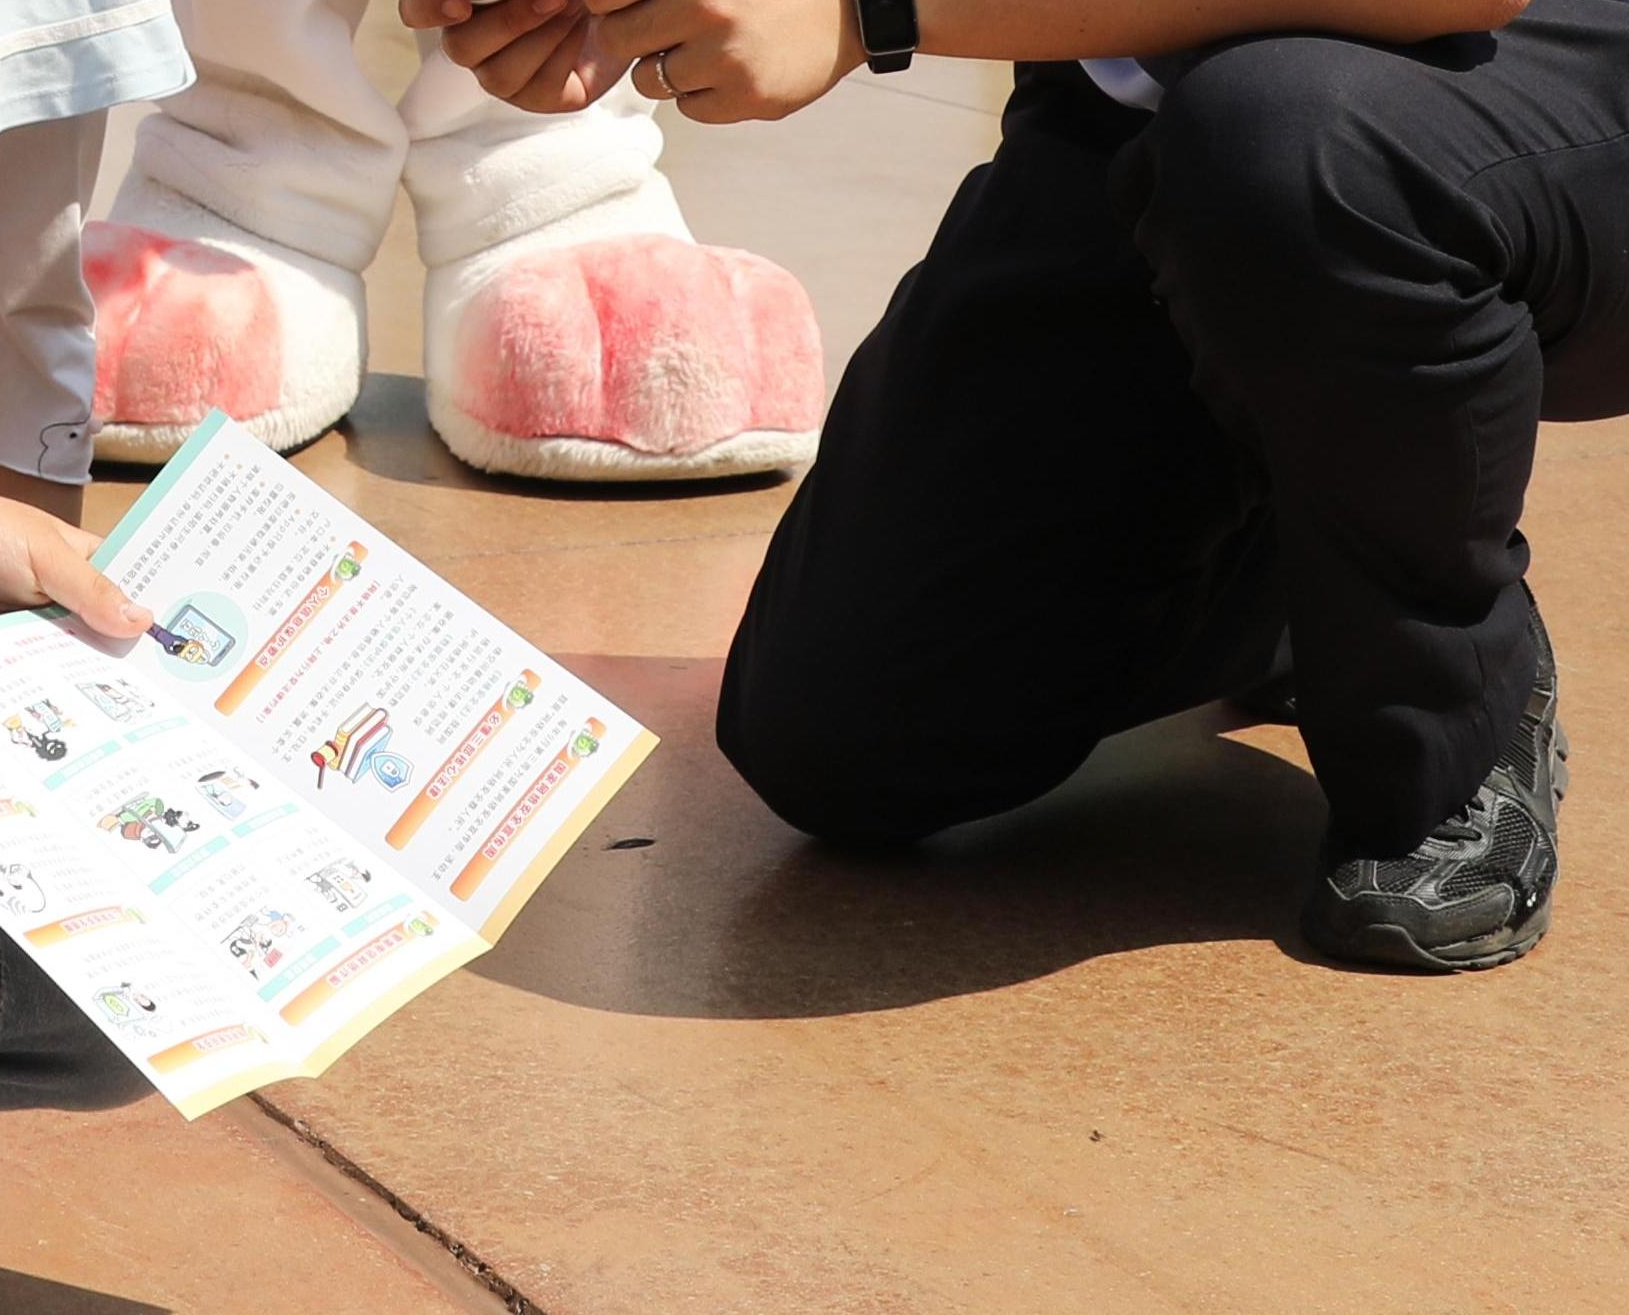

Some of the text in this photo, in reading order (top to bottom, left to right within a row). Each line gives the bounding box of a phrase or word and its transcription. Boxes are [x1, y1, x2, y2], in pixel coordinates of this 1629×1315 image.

[256, 585, 330, 668] 个人信息保护要点
[427, 712, 502, 799] 必懂三部核心法律
[482, 760, 567, 860] 国家网络安全宣传周
